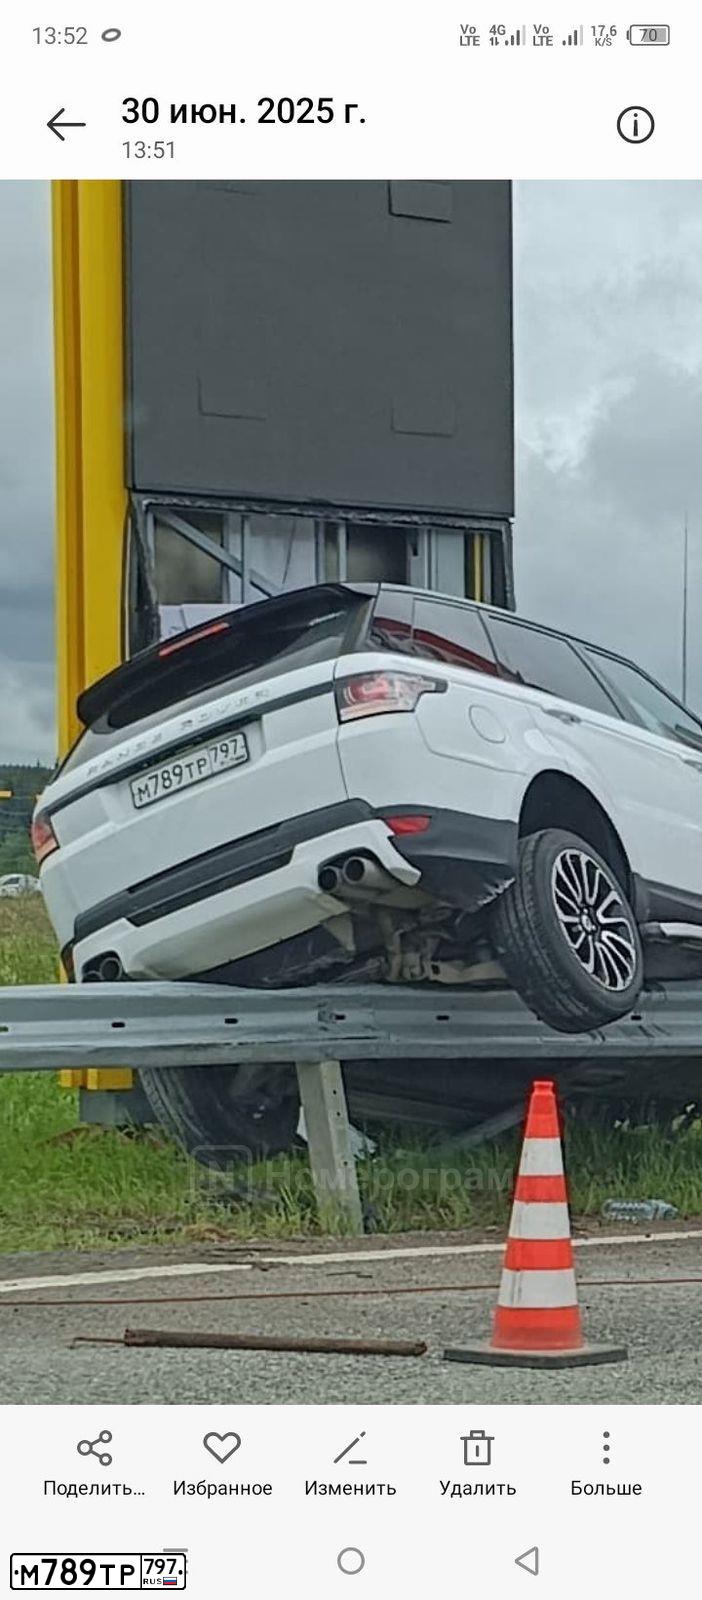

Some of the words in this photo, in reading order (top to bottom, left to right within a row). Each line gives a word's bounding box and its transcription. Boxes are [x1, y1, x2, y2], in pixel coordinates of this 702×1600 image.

[32, 26, 88, 45] 13:52
[460, 24, 477, 35] Vo
[489, 24, 506, 36] 4G
[533, 24, 550, 35] Vo
[591, 24, 618, 38] 17,6
[639, 28, 658, 42] 70
[459, 35, 480, 47] LTE
[532, 35, 554, 47] LTE
[594, 37, 613, 47] K/S
[121, 96, 160, 124] 30
[170, 103, 246, 124] июн.
[257, 96, 335, 124] 2025
[344, 103, 366, 124] г.
[122, 140, 174, 159] 13:51
[210, 738, 238, 764] 797
[173, 1479, 273, 1500] Избранное
[305, 1480, 397, 1496] Изменить
[439, 1480, 517, 1499] Удалить
[571, 1480, 643, 1496] Больше
